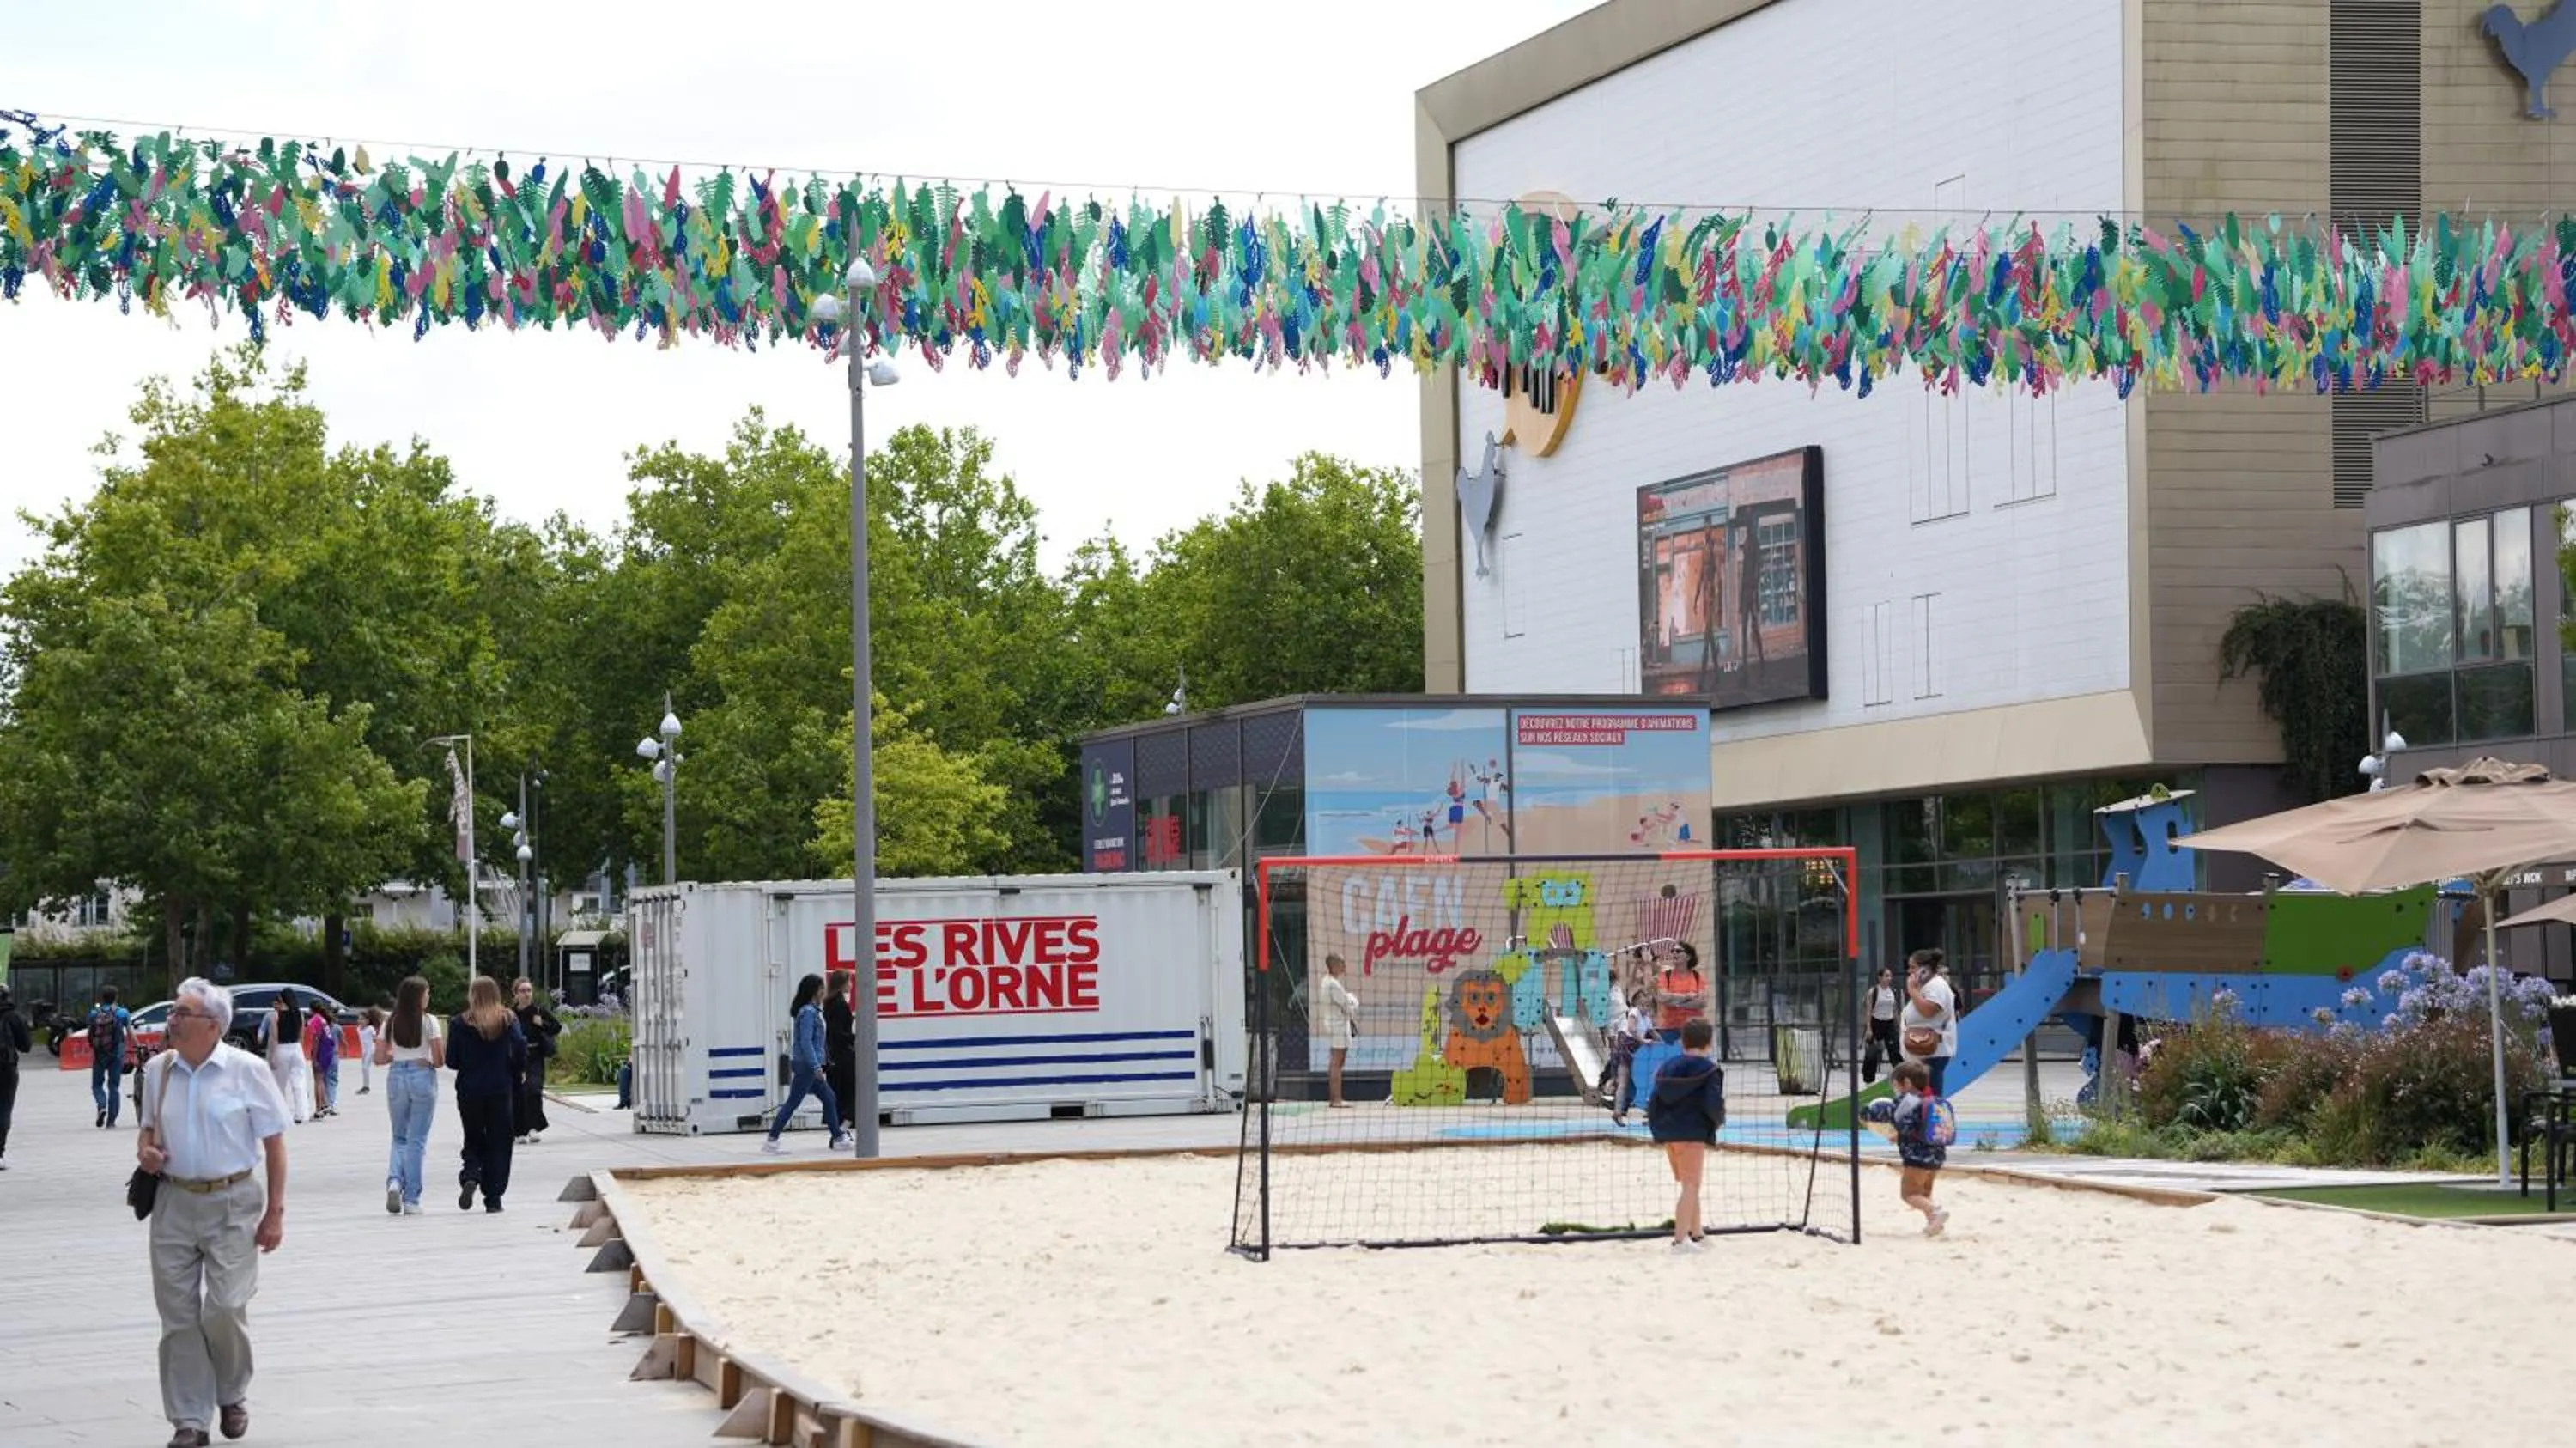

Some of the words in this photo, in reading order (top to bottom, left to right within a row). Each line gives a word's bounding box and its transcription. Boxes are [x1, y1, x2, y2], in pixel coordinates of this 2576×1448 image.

[1342, 874, 1463, 935] CAEN
[825, 925, 927, 970] LES
[944, 921, 1100, 966] RIVES
[1363, 914, 1482, 977] plage
[913, 964, 1100, 1012] L'ORNE
